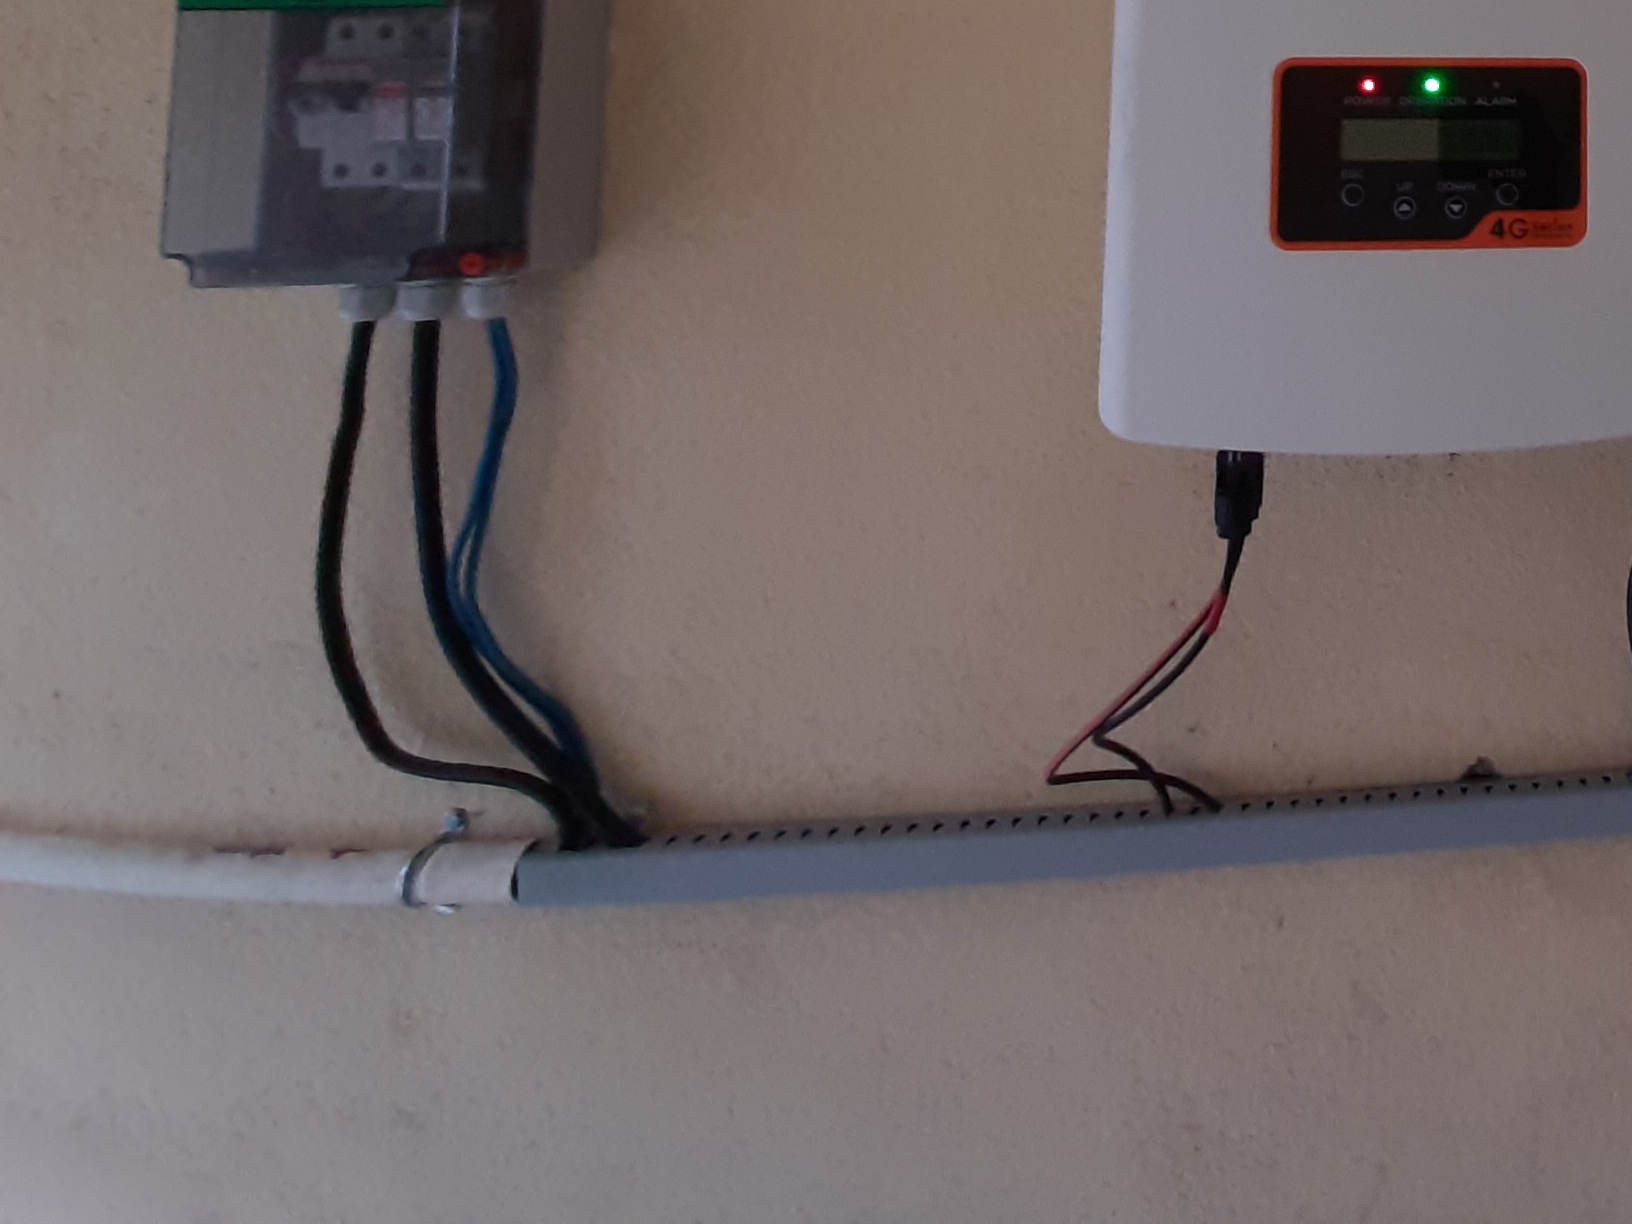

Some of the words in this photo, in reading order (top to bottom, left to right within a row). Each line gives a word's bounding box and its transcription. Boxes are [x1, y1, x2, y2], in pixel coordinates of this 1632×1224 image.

[1343, 96, 1391, 106] POWER
[1474, 96, 1518, 107] ALARM
[1488, 167, 1527, 179] ENTER
[1436, 181, 1477, 192] DOWN
[1489, 217, 1529, 239] 4G
